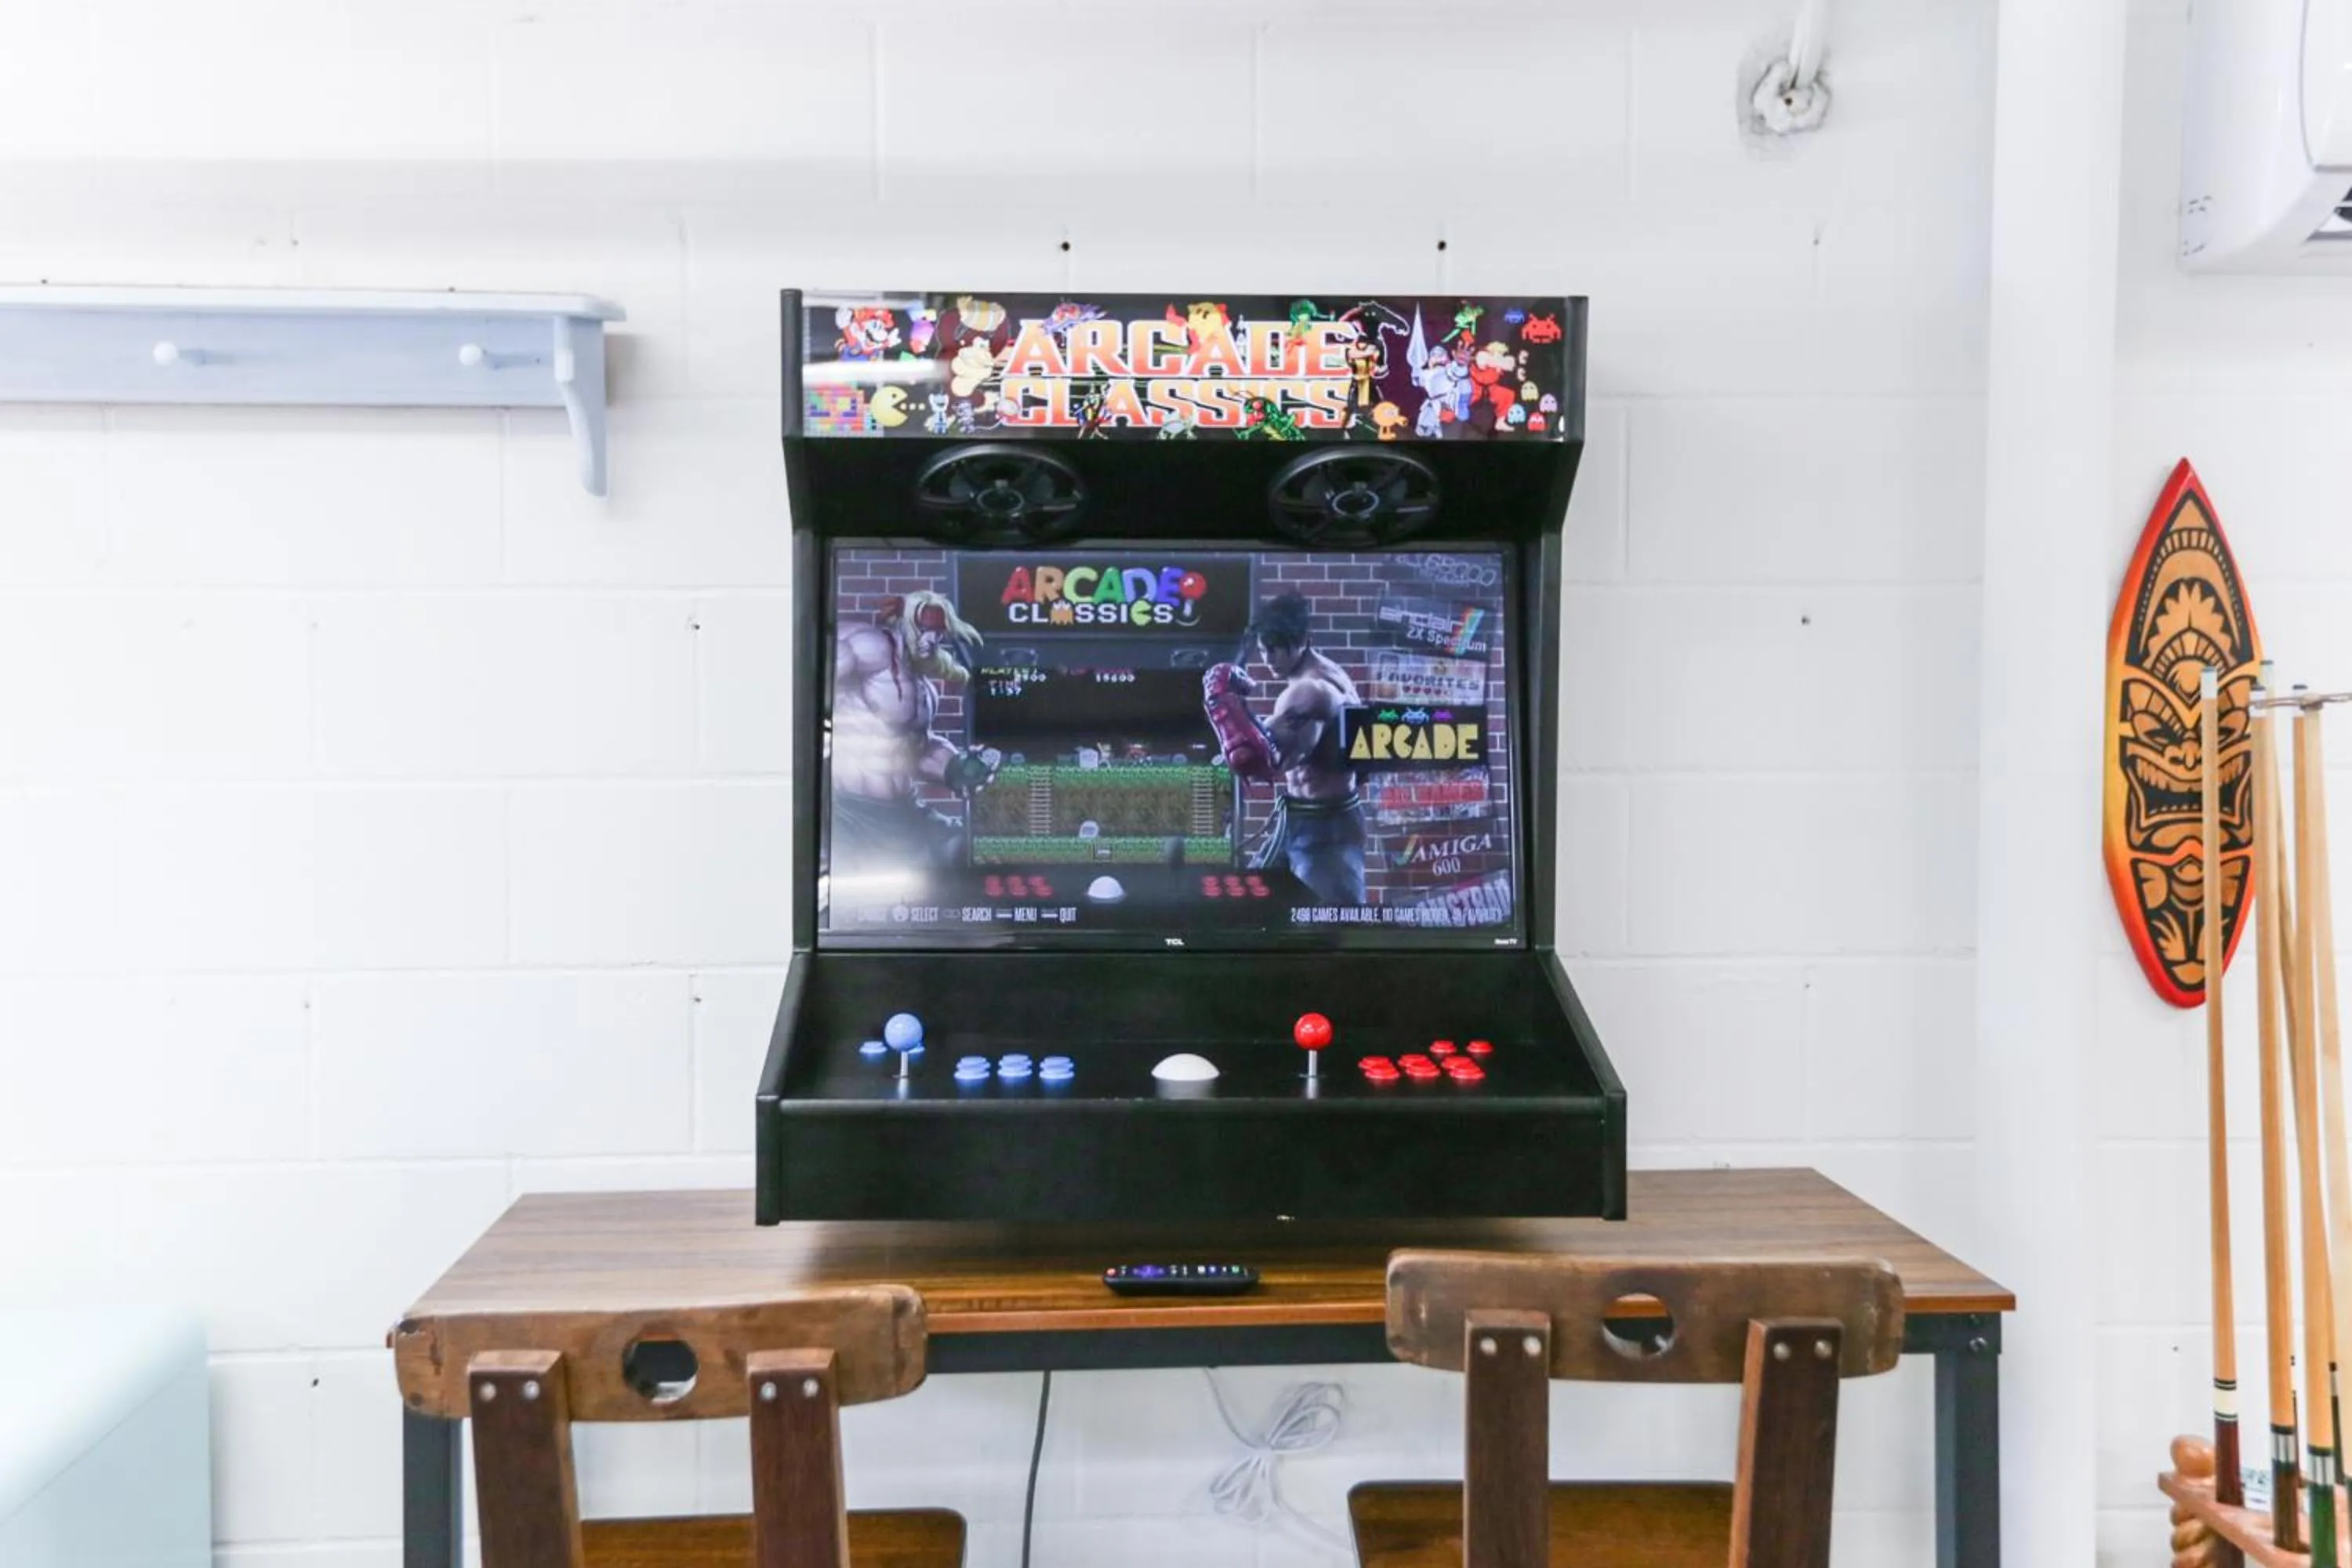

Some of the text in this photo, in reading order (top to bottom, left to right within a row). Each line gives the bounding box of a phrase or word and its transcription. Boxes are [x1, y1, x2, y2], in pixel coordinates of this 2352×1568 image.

[1001, 320, 1357, 377] ARCADE
[1001, 565, 1181, 607] ARCADE
[1349, 723, 1479, 759] ARCADE
[1411, 833, 1492, 863] AMIGA
[1432, 857, 1461, 877] 600
[962, 906, 992, 922] SEARCH
[1014, 906, 1037, 922] MENU
[1059, 906, 1077, 924] QUIT
[1312, 906, 1338, 923] GAMES
[1165, 938, 1185, 946] TCL
